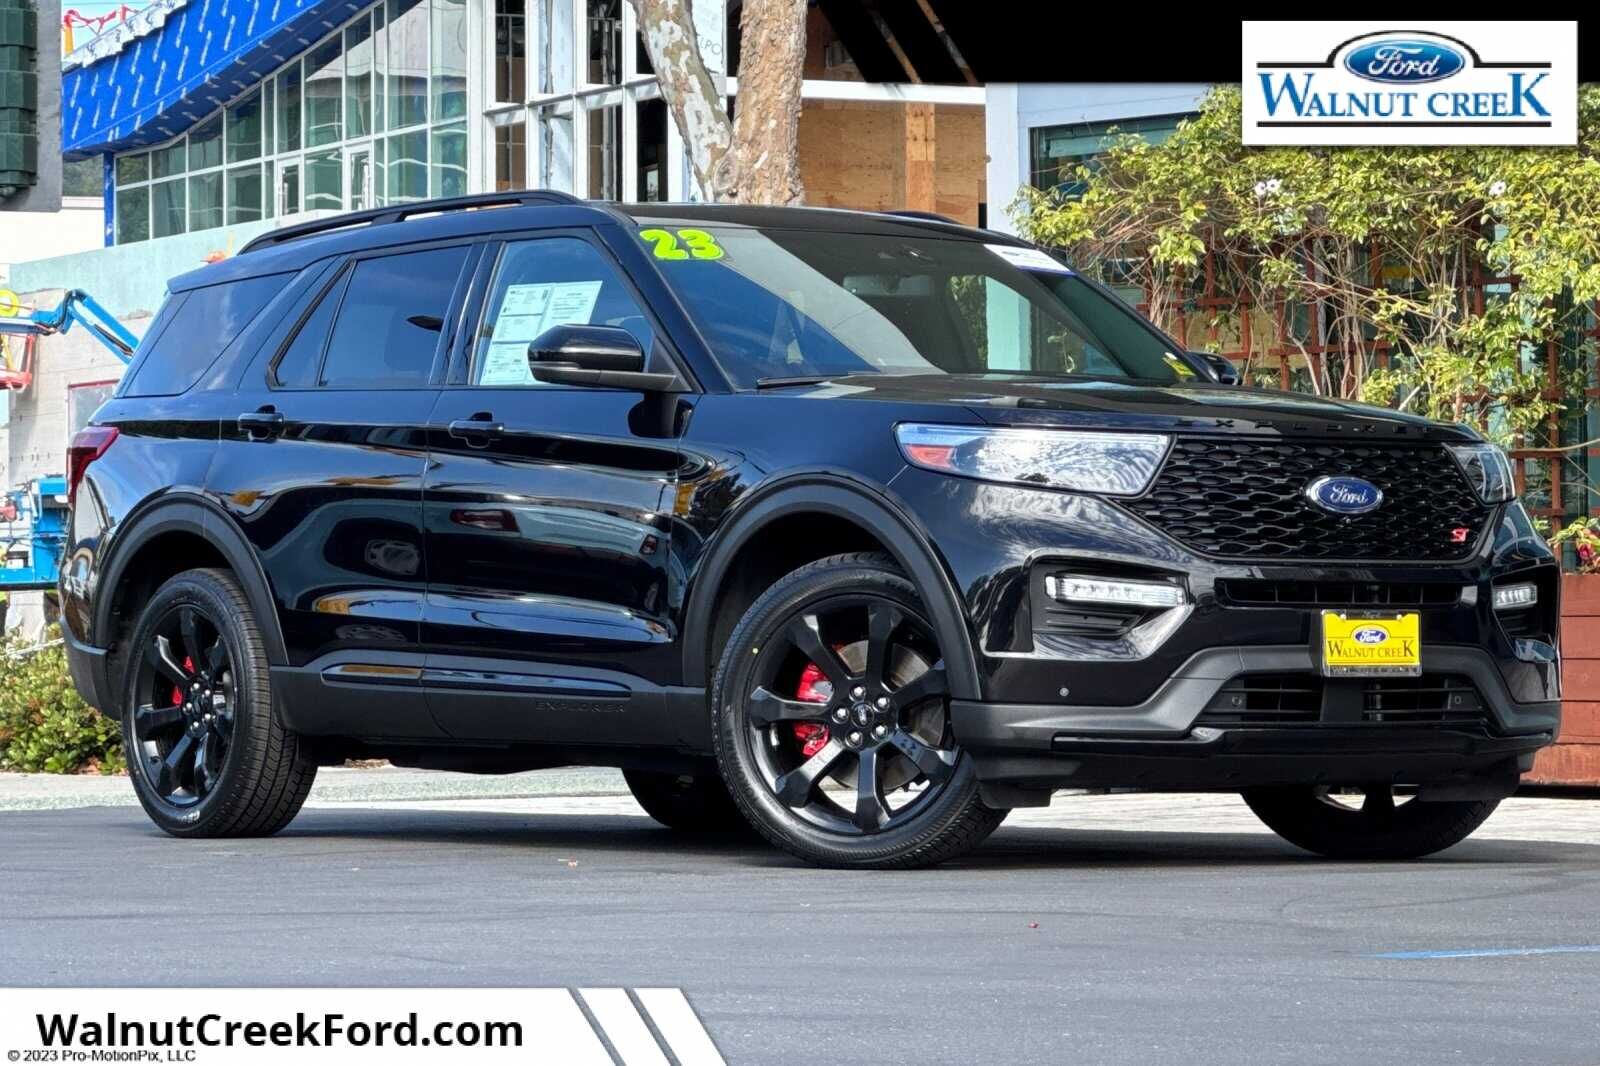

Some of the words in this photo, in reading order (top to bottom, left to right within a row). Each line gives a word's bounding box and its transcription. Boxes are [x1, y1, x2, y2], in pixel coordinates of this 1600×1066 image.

[640, 229, 724, 260] 23
[1330, 485, 1369, 504] Ford
[1359, 630, 1381, 643] Ford
